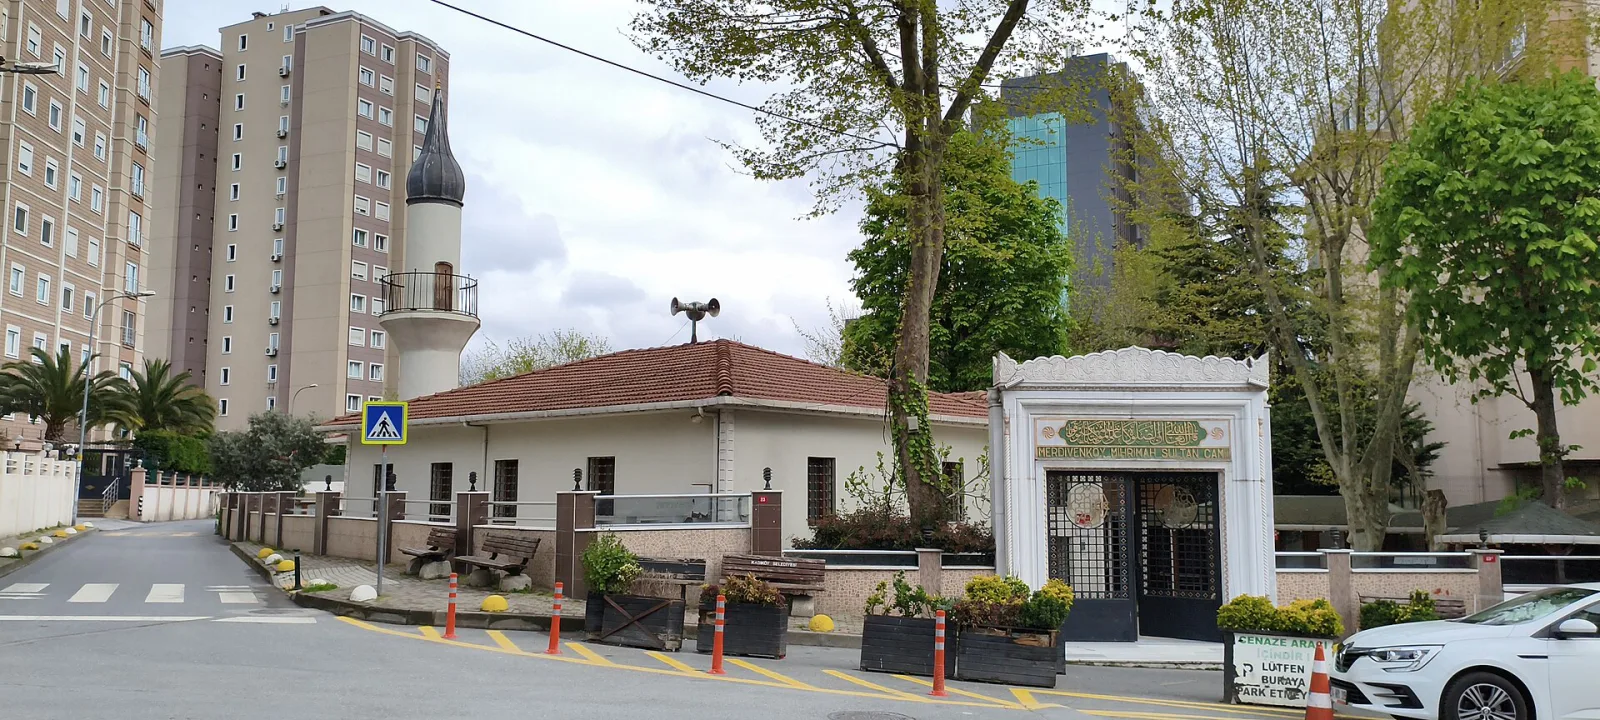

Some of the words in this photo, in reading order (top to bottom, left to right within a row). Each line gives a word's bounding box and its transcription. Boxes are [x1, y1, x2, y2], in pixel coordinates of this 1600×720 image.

[1162, 448, 1199, 459] SULTAN
[1238, 635, 1287, 647] CENAZE
[1291, 639, 1328, 650] ARAI
[1261, 661, 1305, 674] LÜTFEN
[1261, 675, 1306, 687] BURAYA
[1236, 686, 1266, 698] PARK
